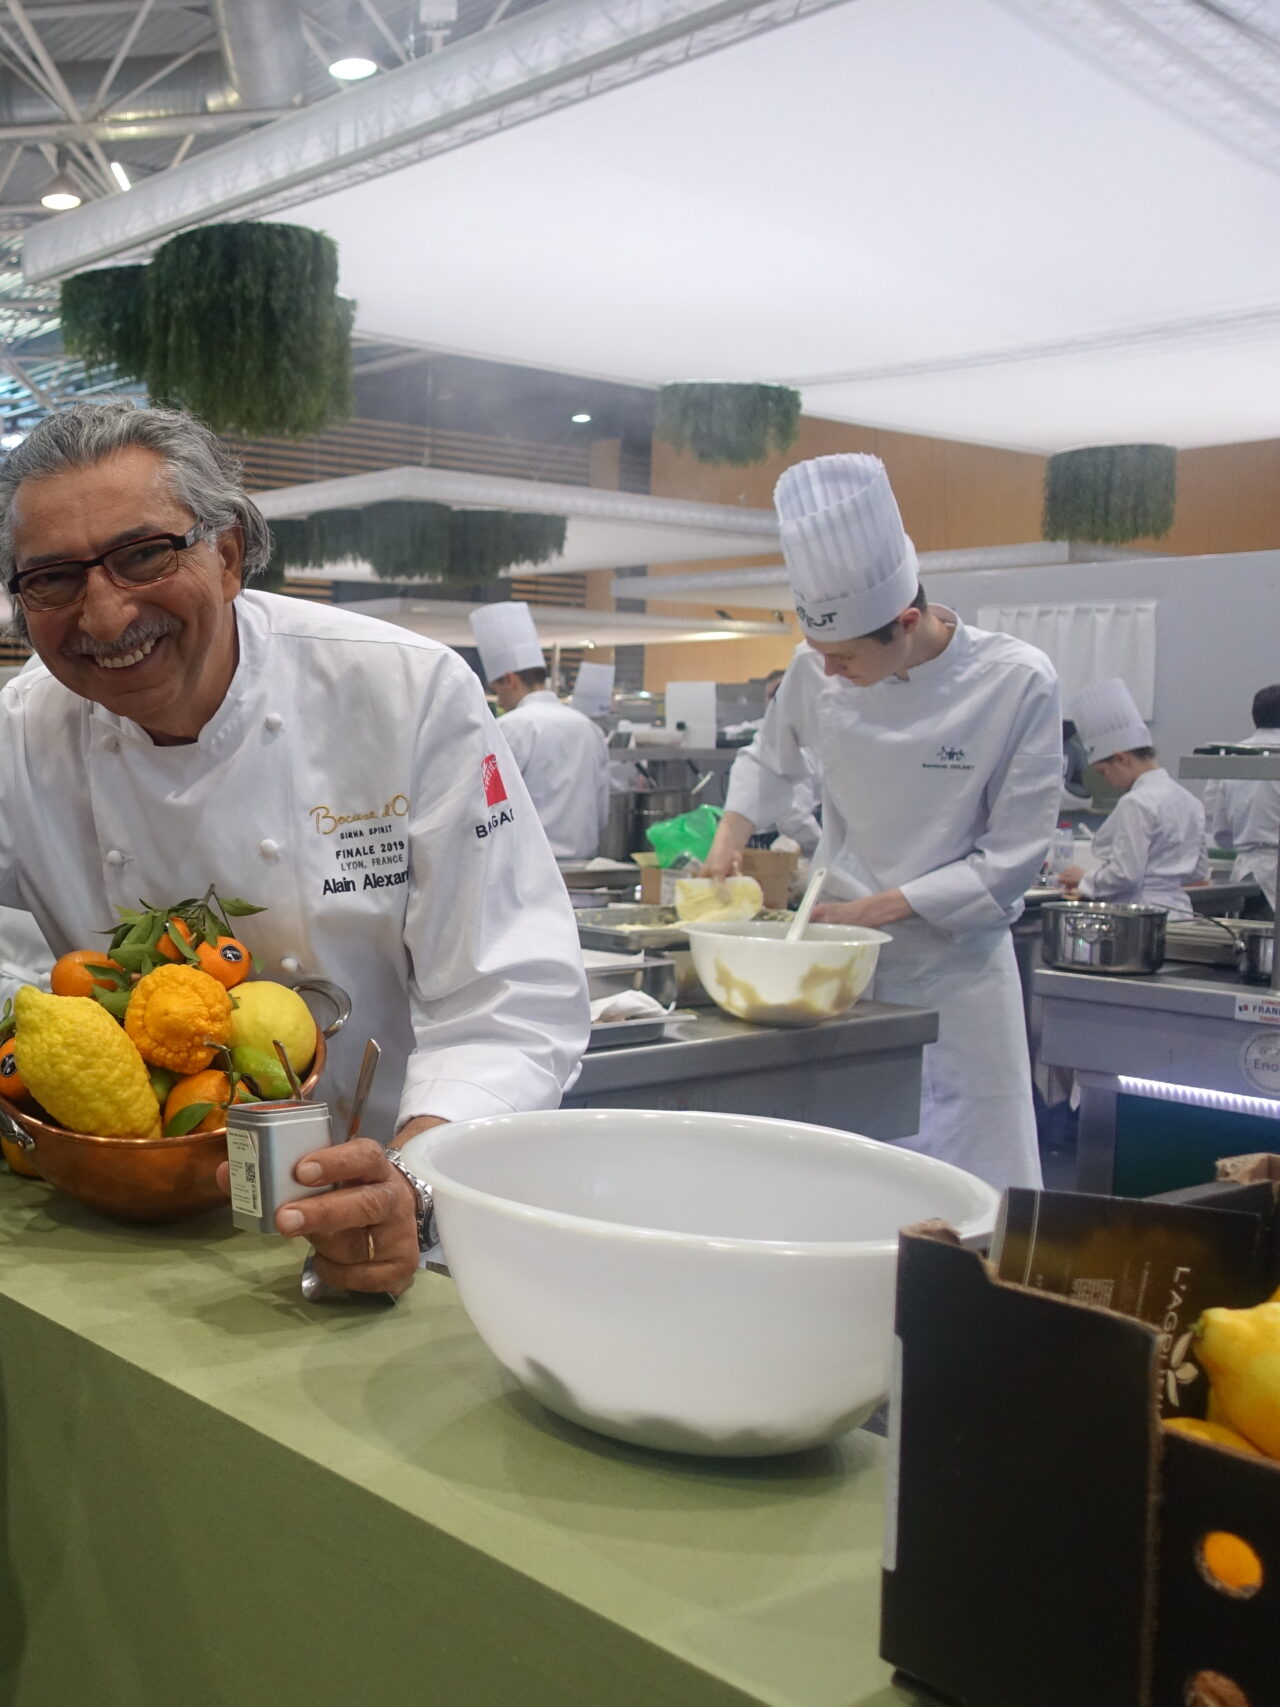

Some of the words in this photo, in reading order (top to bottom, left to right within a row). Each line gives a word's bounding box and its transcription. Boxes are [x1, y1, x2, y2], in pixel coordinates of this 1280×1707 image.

[308, 805, 378, 836] Bocuse
[340, 828, 364, 840] SIRHA
[369, 824, 392, 836] SPIRIT
[335, 845, 375, 860] FINALE
[380, 840, 405, 853] 2019
[340, 859, 367, 871] LYON,
[371, 854, 404, 867] FRANCE
[322, 877, 357, 896] Alain
